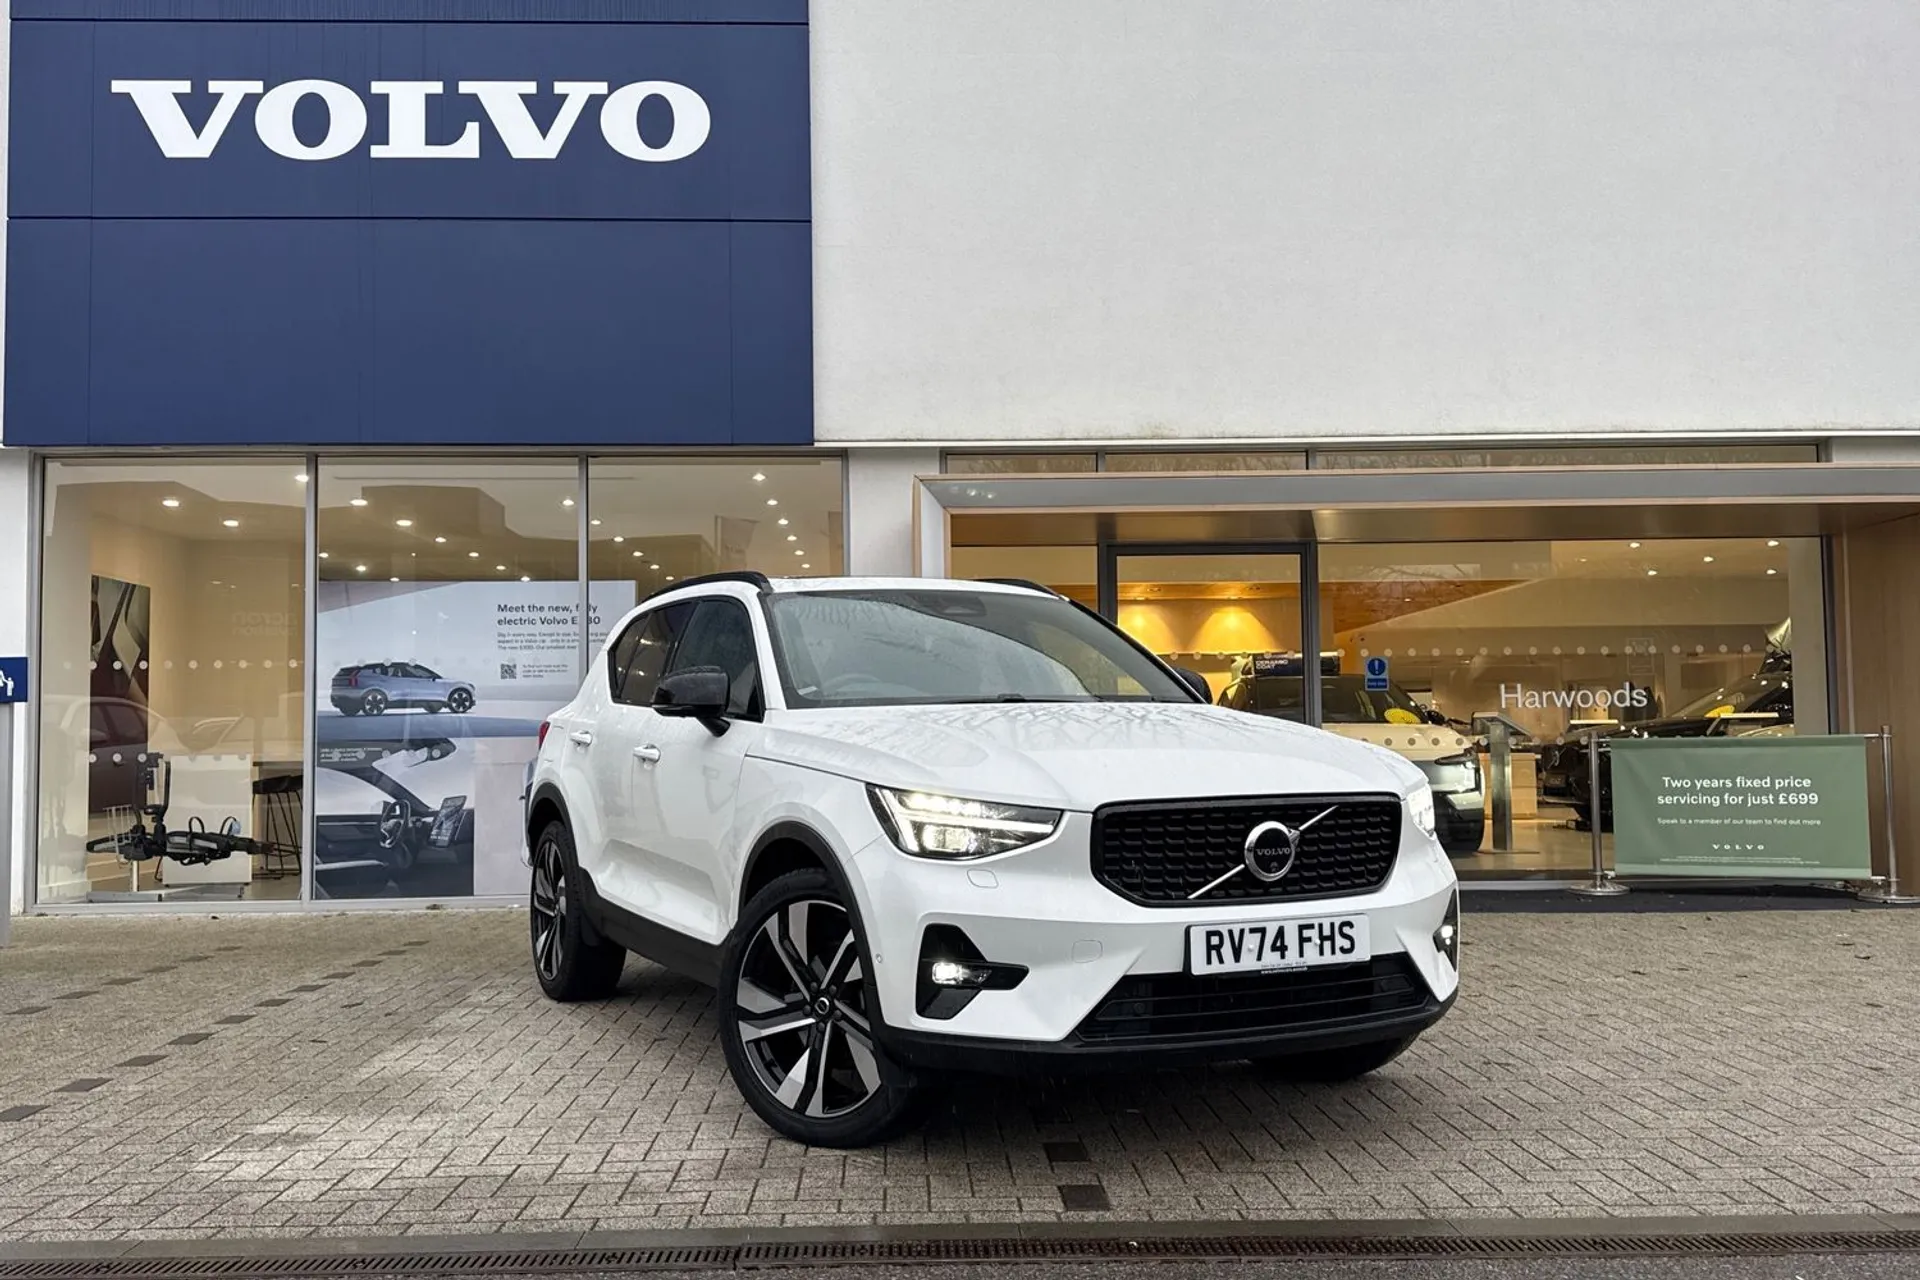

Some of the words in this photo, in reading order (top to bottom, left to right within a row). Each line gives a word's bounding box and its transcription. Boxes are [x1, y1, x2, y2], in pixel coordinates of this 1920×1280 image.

[111, 79, 711, 162] VOLVO
[497, 604, 525, 613] Meet
[528, 604, 545, 613] the
[548, 604, 573, 614] new,
[497, 617, 537, 626] electric
[539, 616, 568, 626] Volvo
[1499, 681, 1648, 709] Harwoods
[1662, 776, 1691, 788] Two
[1694, 778, 1732, 790] years
[1735, 776, 1771, 788] fixed
[1774, 776, 1812, 790] price
[1657, 792, 1720, 807] servicing
[1724, 792, 1744, 805] for
[1747, 792, 1774, 807] just
[1778, 792, 1819, 805] £699
[1657, 817, 1678, 825] Speak
[1255, 847, 1291, 856] VOLVO
[1711, 843, 1765, 851] VOLVO
[1205, 925, 1289, 966] RV74
[1297, 920, 1356, 959] FHS
